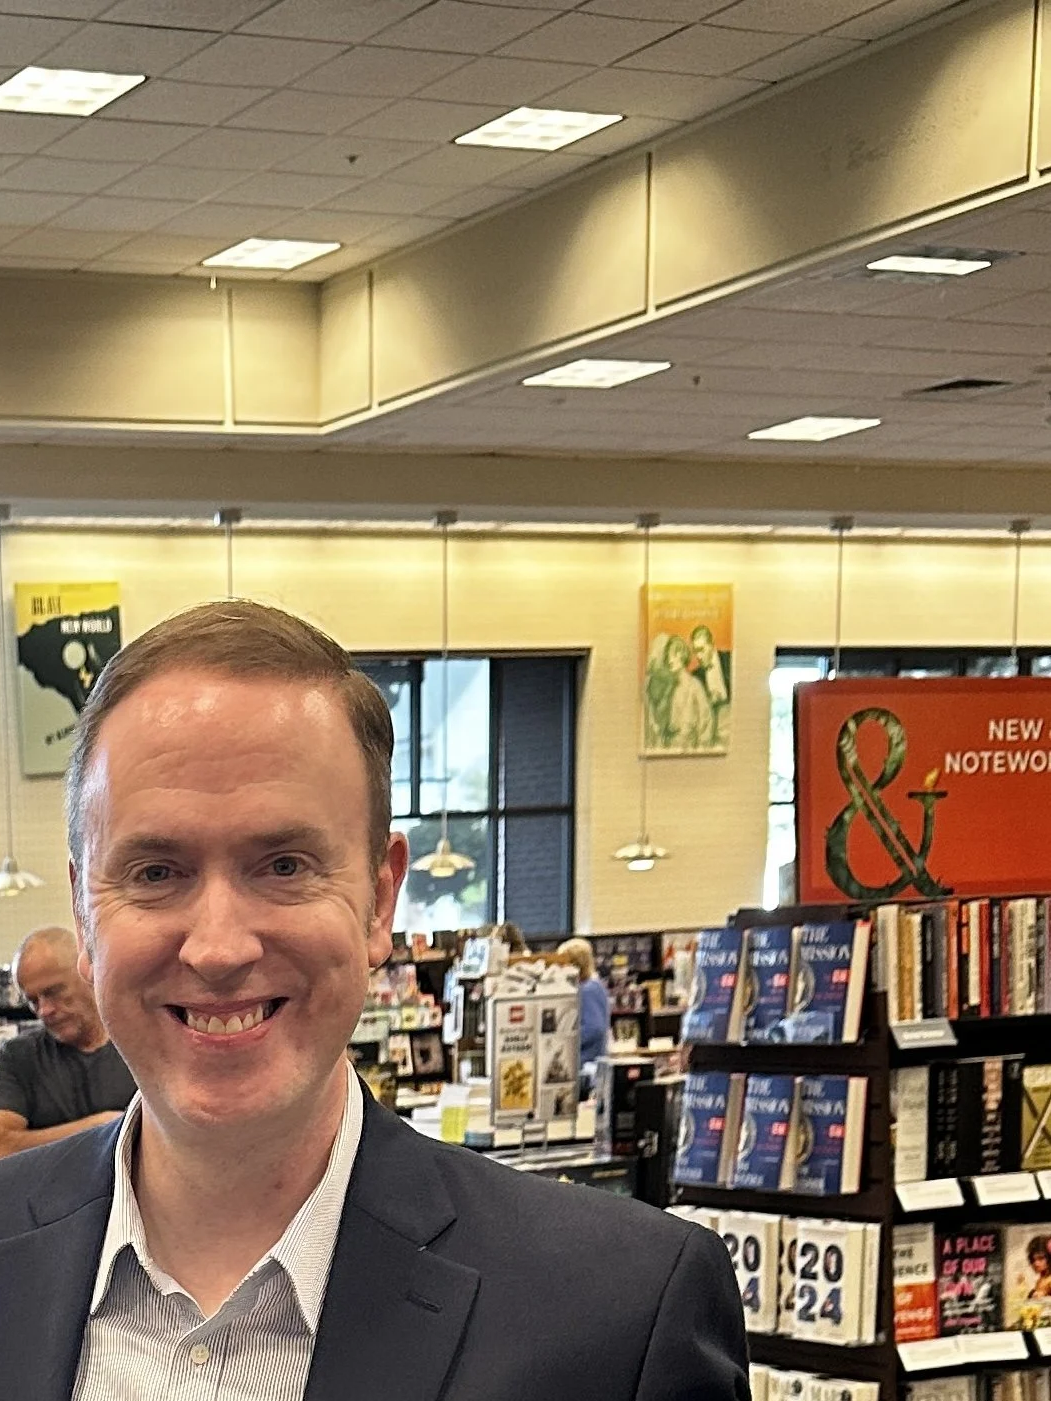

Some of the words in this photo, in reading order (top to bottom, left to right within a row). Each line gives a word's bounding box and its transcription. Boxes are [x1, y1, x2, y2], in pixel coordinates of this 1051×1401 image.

[60, 619, 80, 634] NEW
[81, 617, 113, 634] WORLD
[988, 717, 1044, 741] NEW
[942, 1239, 952, 1255] A
[955, 1234, 996, 1254] PLACE
[800, 1241, 843, 1283] 20
[942, 1258, 959, 1275] OF
[961, 1256, 987, 1274] OUR
[742, 1276, 760, 1313] 4
[797, 1283, 843, 1326] 24
